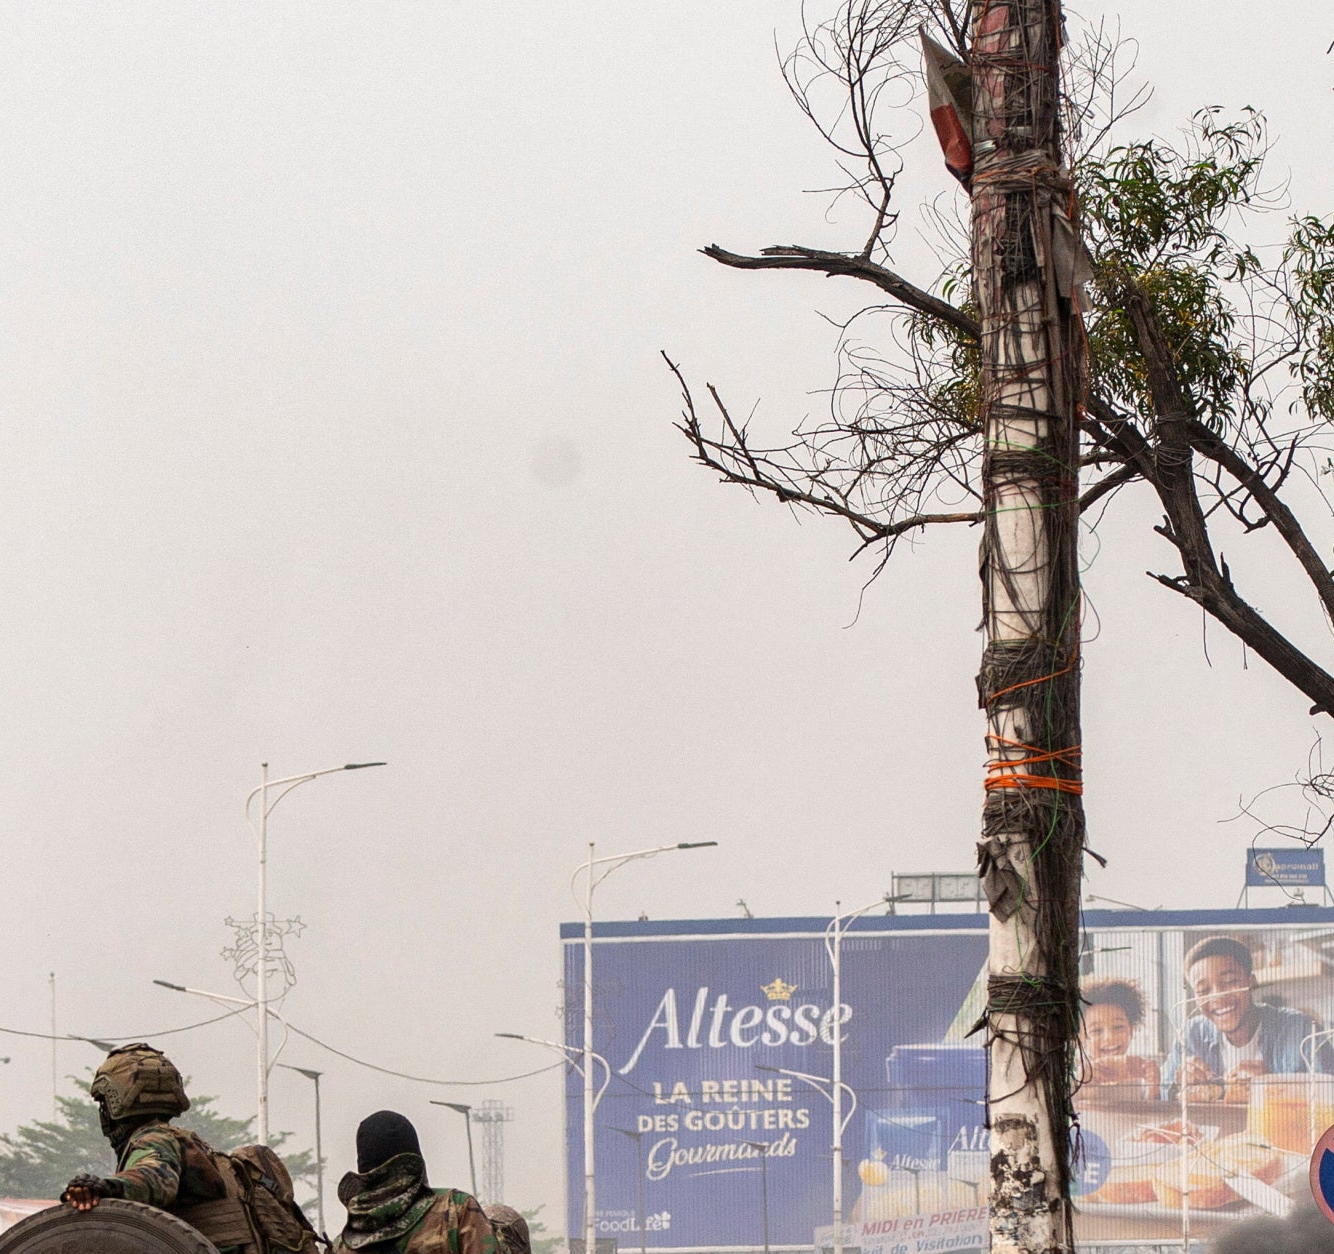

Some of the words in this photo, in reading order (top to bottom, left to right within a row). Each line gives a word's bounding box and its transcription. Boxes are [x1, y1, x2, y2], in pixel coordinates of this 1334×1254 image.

[618, 986, 854, 1075] Altesse
[652, 1080, 692, 1105] LA
[702, 1078, 793, 1103] REINE
[637, 1114, 679, 1133] DES
[685, 1105, 810, 1131] GOÛTERS
[646, 1132, 798, 1181] Gourmands
[861, 1219, 899, 1237] MIDI
[903, 1218, 925, 1231] en
[929, 1206, 990, 1228] PRIERE
[916, 1233, 984, 1253] Visitation
